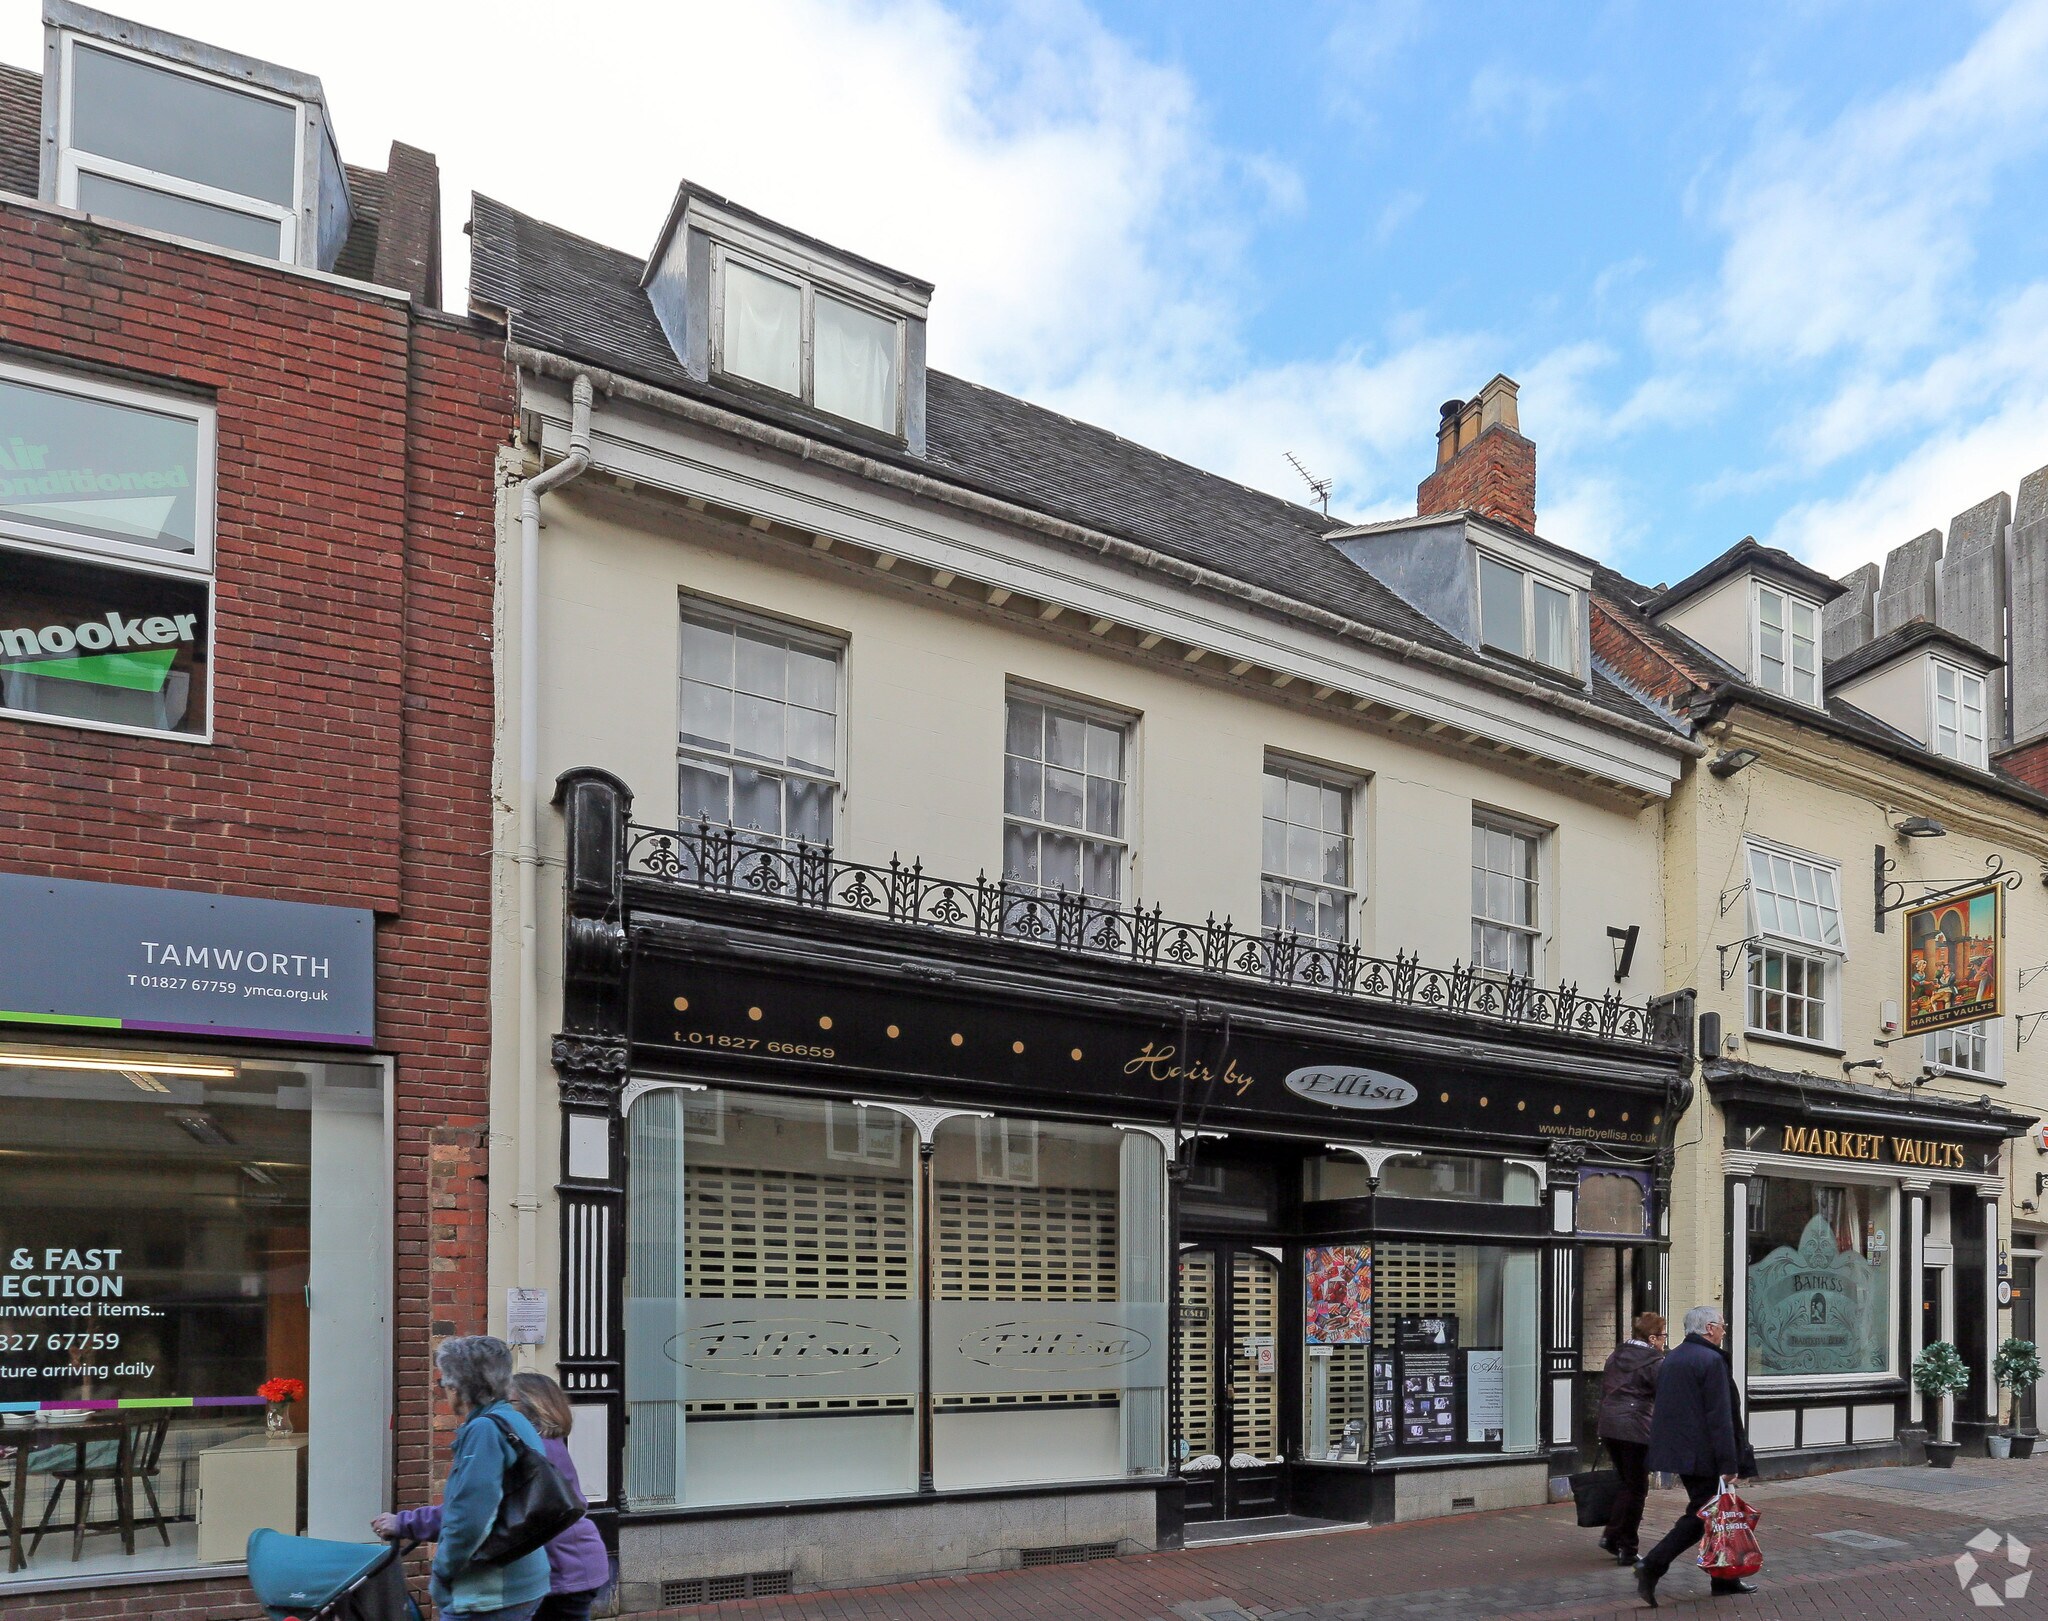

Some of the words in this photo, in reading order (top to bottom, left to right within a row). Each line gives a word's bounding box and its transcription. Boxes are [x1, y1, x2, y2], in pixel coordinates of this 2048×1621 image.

[0, 611, 197, 657] nooker
[141, 941, 329, 979] TAMWORTH
[127, 974, 138, 986] T
[141, 975, 187, 990] 01827
[191, 979, 236, 993] 67759
[244, 984, 328, 1002] ymca.org.uk
[1911, 1012, 1951, 1027] MARKET
[1953, 1002, 1994, 1017] VAULTS
[673, 1031, 760, 1050] t.01827
[767, 1041, 835, 1059] 66659
[1124, 1042, 1214, 1081] Hair
[1223, 1059, 1255, 1096] by
[1300, 1073, 1408, 1101] Ellisa
[1539, 1124, 1659, 1144] www.hairbyellisa.co.uk
[1782, 1125, 1884, 1160] MARKET
[1891, 1136, 1964, 1169] VAULTS
[10, 1248, 34, 1270] &
[45, 1248, 122, 1271] FAST
[98, 1302, 165, 1316] items...
[47, 1333, 120, 1351] 67759
[42, 1363, 109, 1379] arriving
[114, 1362, 155, 1378] daily
